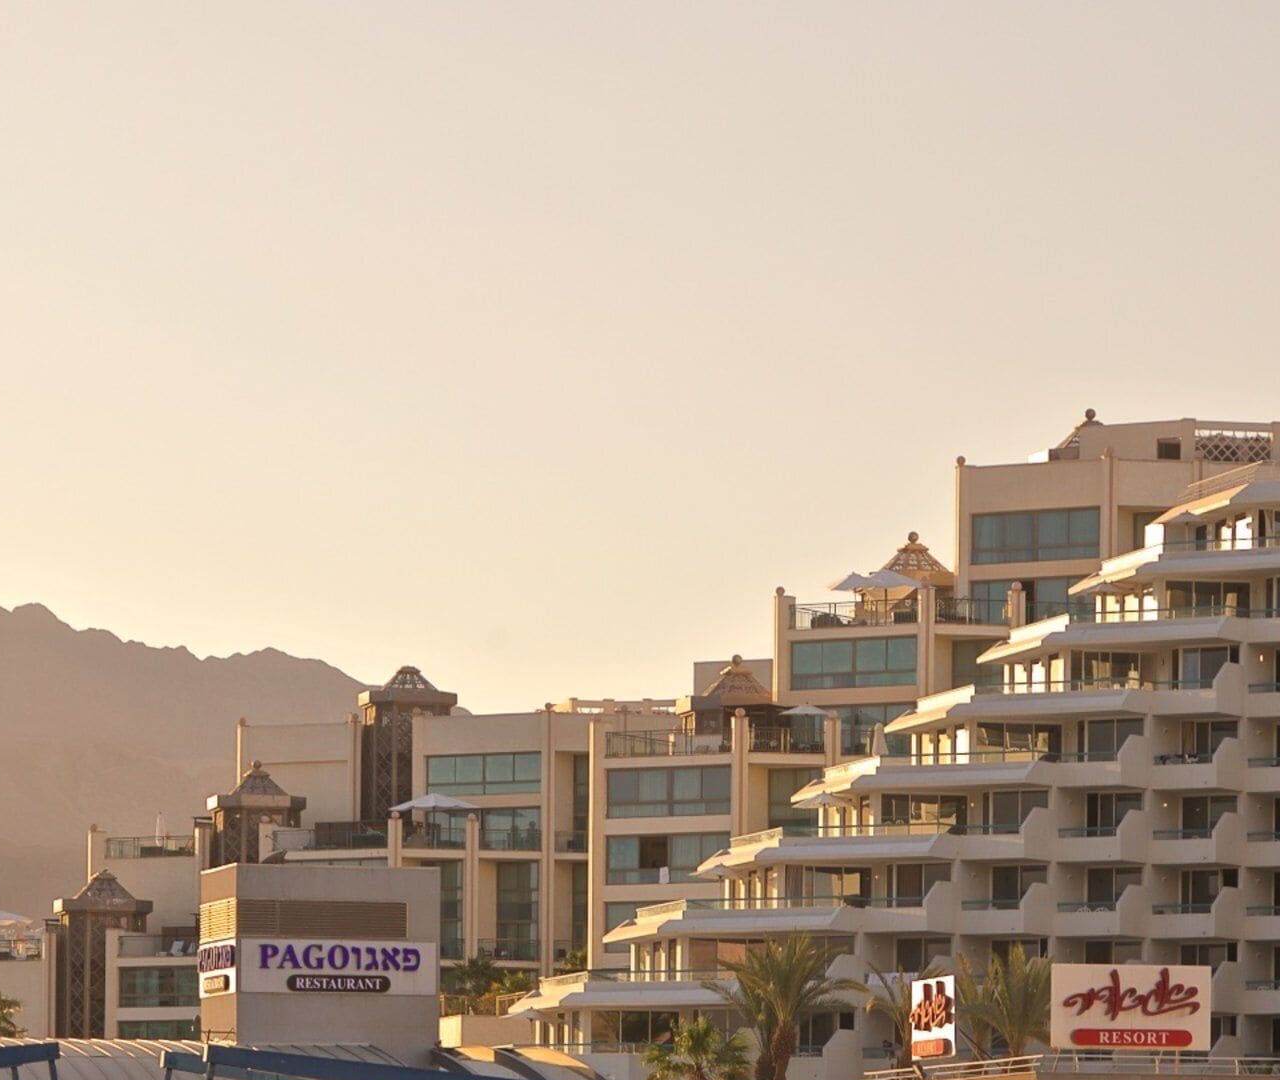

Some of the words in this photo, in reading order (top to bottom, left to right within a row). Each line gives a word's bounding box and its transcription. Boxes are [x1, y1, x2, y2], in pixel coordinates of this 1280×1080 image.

[258, 943, 351, 970] PAGO
[351, 946, 421, 972] פאגו
[295, 976, 383, 991] RESTAURANT
[1099, 1031, 1169, 1044] RESORT
